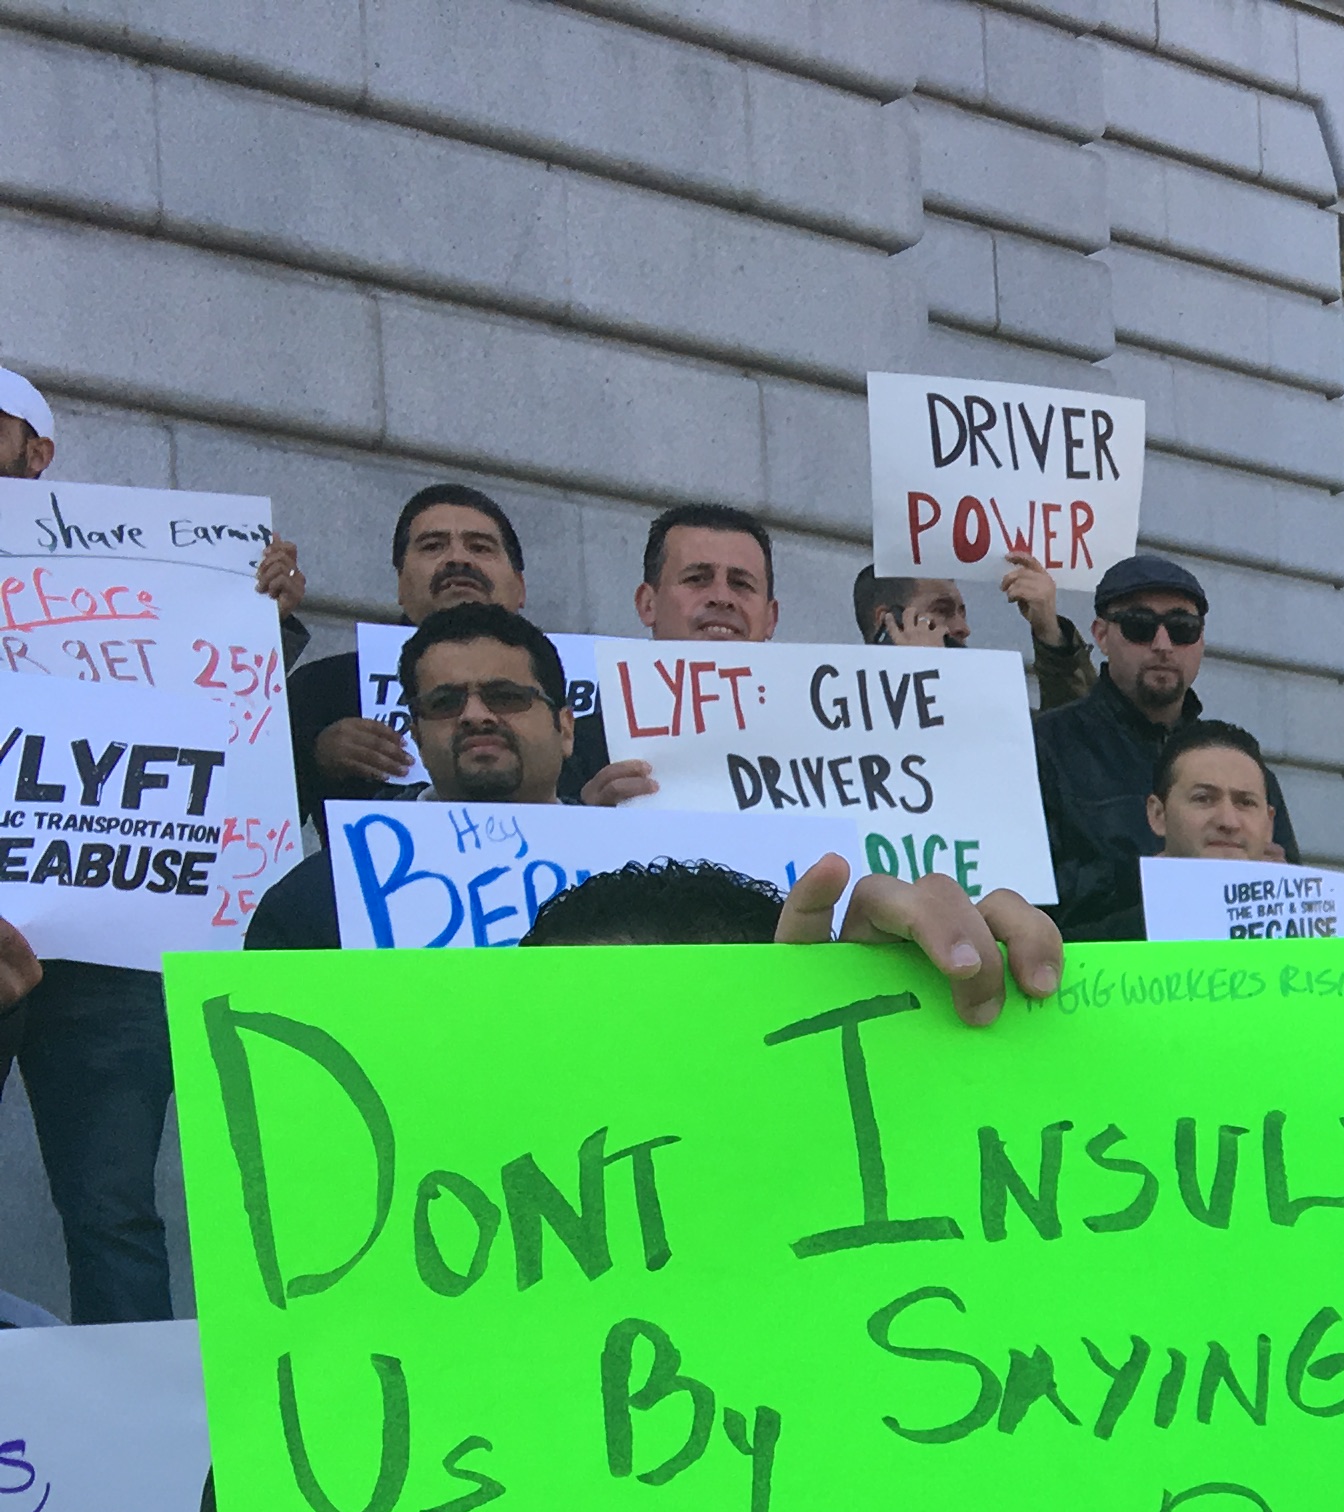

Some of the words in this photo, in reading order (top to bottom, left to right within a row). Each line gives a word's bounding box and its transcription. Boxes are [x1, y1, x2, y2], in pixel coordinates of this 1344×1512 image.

[927, 393, 1119, 481] DRIVER
[907, 492, 1095, 570] POWER
[617, 659, 767, 738] LYFT:
[810, 664, 944, 730] GIVE
[727, 754, 934, 815] DRIVERS
[34, 812, 220, 845] TRANSPORTATION
[448, 808, 529, 859] Hey
[1224, 876, 1323, 905] UBER/LYFT
[1227, 908, 1253, 921] THE
[1258, 903, 1284, 918] BAIT
[1289, 902, 1297, 914] &
[1301, 900, 1336, 914] SWITCH
